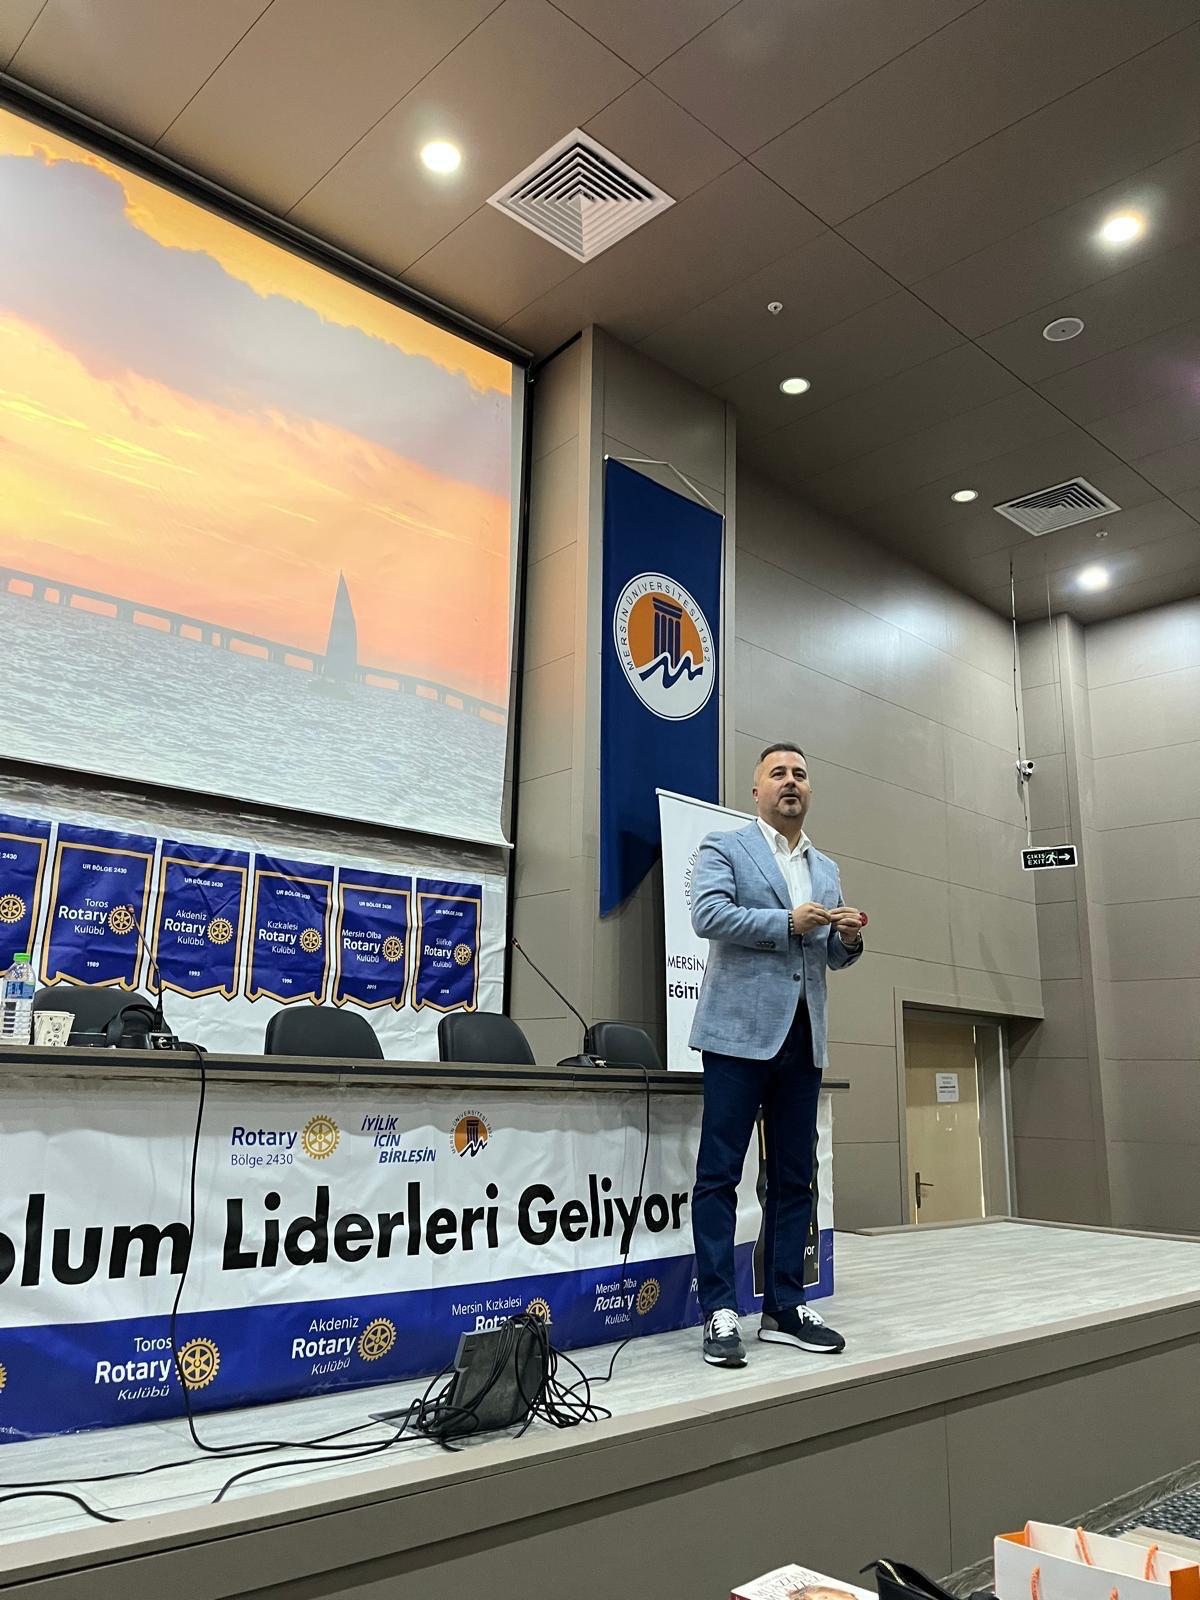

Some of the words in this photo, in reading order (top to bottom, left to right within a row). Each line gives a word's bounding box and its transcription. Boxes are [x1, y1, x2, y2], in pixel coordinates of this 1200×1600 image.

[92, 864, 113, 873] BÖLGE
[113, 866, 128, 874] 2430
[85, 898, 108, 908] Toros
[58, 905, 107, 924] Rotary
[176, 909, 207, 920] Akdeniz
[74, 924, 105, 935] Kulübü
[164, 918, 206, 936] Rotary
[267, 920, 298, 931] Kızkalesi
[177, 936, 205, 946] Kulübü
[258, 929, 297, 945] Rotary
[342, 929, 365, 938] Mersin
[366, 931, 382, 940] Olba
[272, 945, 296, 955] Kulübü
[343, 938, 380, 954] Rotary
[424, 945, 452, 959] Rotary
[356, 953, 379, 963] Kulübü
[667, 954, 705, 971] MERSİN
[669, 980, 699, 1000] EĞİTİ
[361, 1114, 399, 1131] İYİLİK
[231, 1126, 297, 1149] Rotary
[231, 1154, 263, 1168] Bölge
[266, 1153, 293, 1165] 2430
[378, 1146, 437, 1164] BİRLEŞİN
[222, 1181, 499, 1271] Liderleri
[518, 1173, 689, 1255] Geliyor
[595, 1282, 620, 1295] Mersin
[452, 1300, 483, 1316] Mersin
[486, 1295, 522, 1311] Kızkalesi
[309, 1315, 359, 1333] Akdeniz
[134, 1337, 172, 1352] Toros
[291, 1335, 357, 1360] Rotary
[95, 1359, 172, 1384] Rotary
[311, 1357, 351, 1376] Kulübü
[117, 1385, 170, 1400] Kulübü
